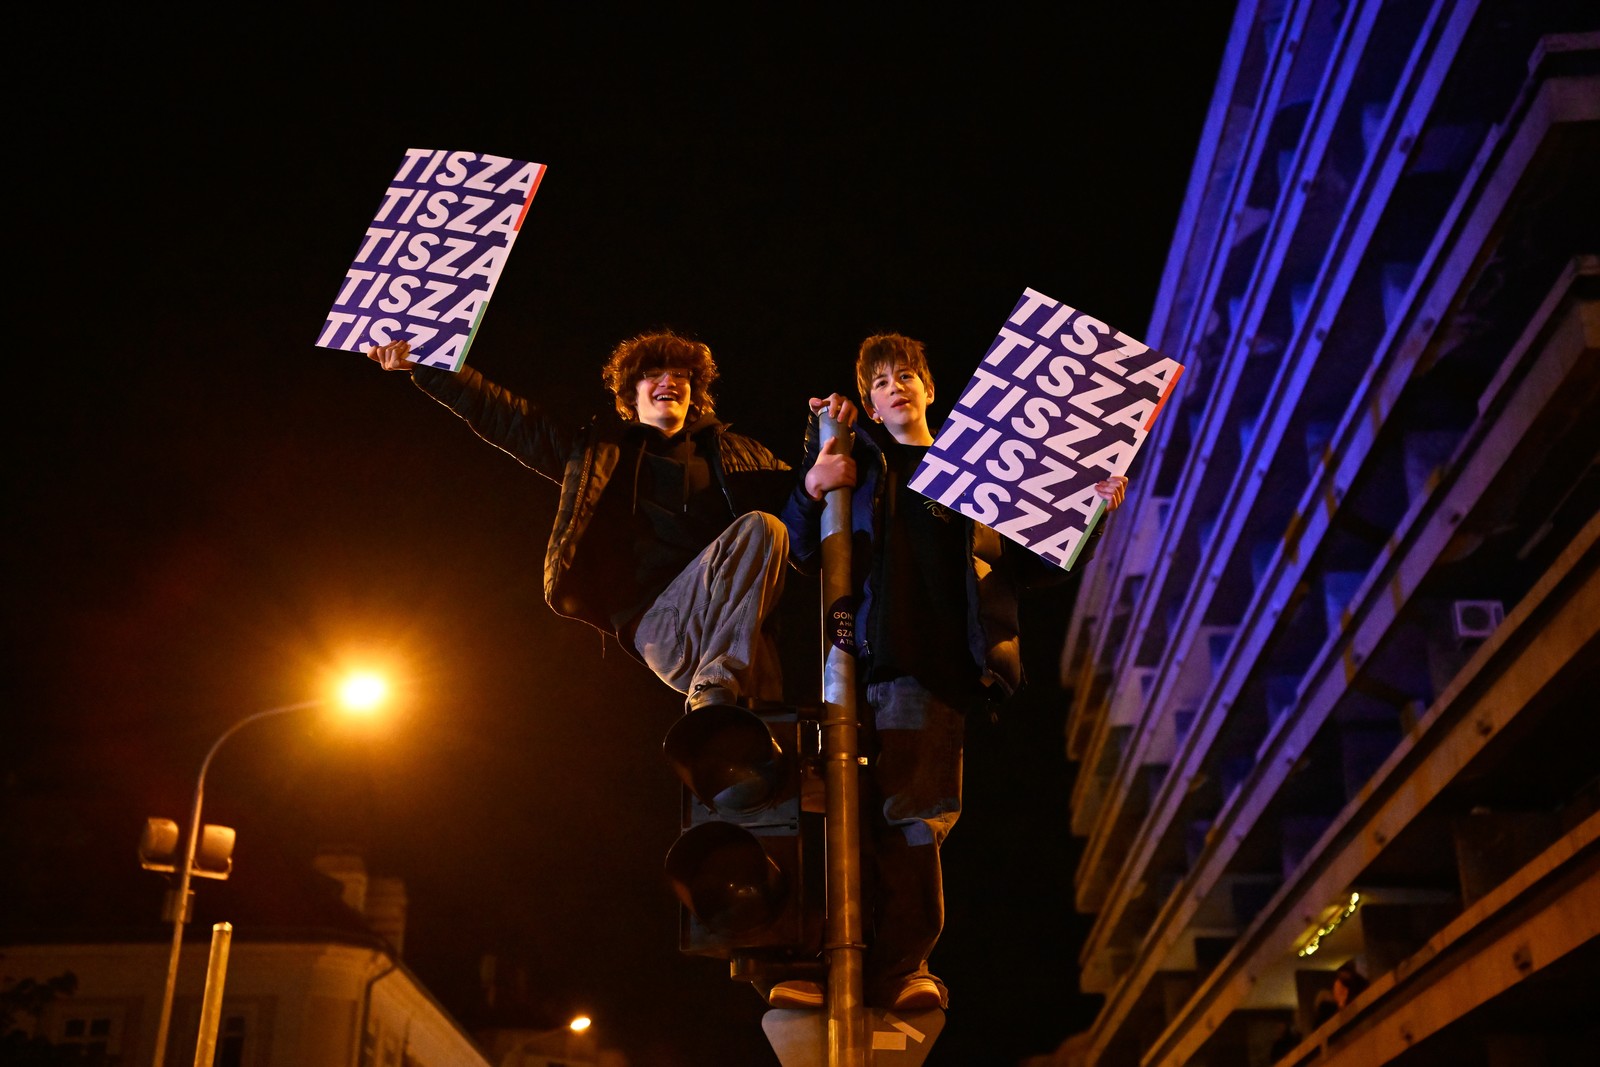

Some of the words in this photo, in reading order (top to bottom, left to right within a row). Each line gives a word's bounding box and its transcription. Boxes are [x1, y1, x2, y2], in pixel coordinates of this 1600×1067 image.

[374, 187, 523, 241] TISZA
[394, 148, 541, 198] TISZA
[354, 227, 506, 284] TISZA
[316, 311, 469, 371] TISZA
[335, 269, 488, 328] TISZA
[985, 327, 1157, 440] TISZA
[1009, 287, 1181, 397] TISZA
[959, 368, 1133, 478] TISZA
[934, 410, 1106, 525] TISZA
[909, 453, 1084, 569] TISZA
